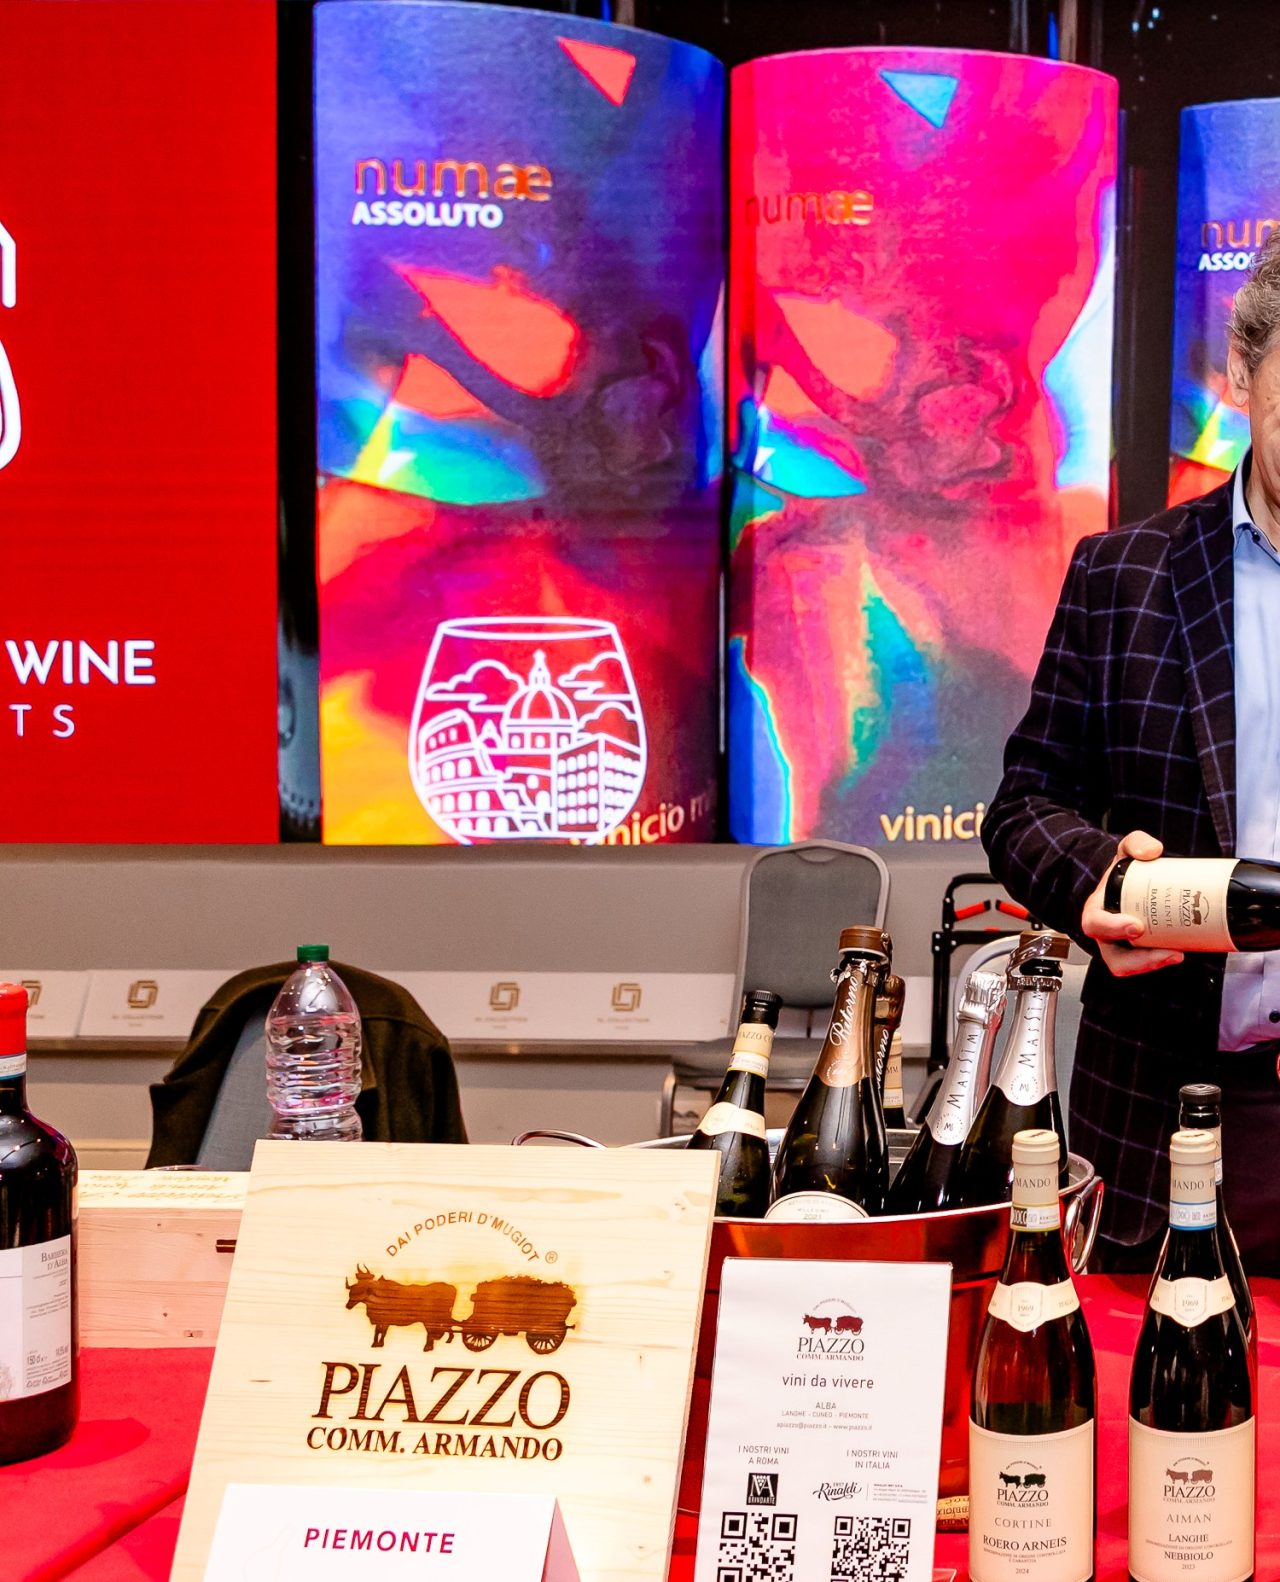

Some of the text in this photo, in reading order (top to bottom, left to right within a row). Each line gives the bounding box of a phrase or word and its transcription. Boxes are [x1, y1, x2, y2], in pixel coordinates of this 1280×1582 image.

[352, 201, 503, 228] ASSOLUTO
[1199, 251, 1254, 271] ASSO
[5, 639, 157, 685] WINE
[879, 803, 986, 842] vinici
[1150, 888, 1159, 926] BAROLO
[1182, 889, 1192, 927] PIAZZO
[386, 1231, 411, 1257] DAI
[414, 1211, 473, 1236] PODERI
[797, 1337, 865, 1355] PIAZZO
[782, 1373, 875, 1390] vini da vivere
[312, 1361, 571, 1431] PIAZZO
[815, 1402, 837, 1410] ALBA
[306, 1426, 564, 1462] COMM. ARMANDO
[743, 1445, 772, 1455] NOSTRI
[773, 1446, 790, 1456] VINI
[748, 1457, 779, 1466] A ROMA
[851, 1449, 881, 1459] NOSTRI
[882, 1450, 899, 1459] VINI
[855, 1461, 891, 1470] IN ITALIA
[812, 1481, 863, 1502] Rinaldi
[997, 1488, 1049, 1503] PIAZZO
[1164, 1485, 1216, 1498] PIAZZO
[994, 1517, 1052, 1529] CORTINE
[1166, 1513, 1212, 1524] AIMAN
[303, 1527, 456, 1555] PIEMONTE
[983, 1534, 1067, 1551] ROERO ARNEIS
[1168, 1533, 1209, 1543] LANGHE
[1164, 1551, 1214, 1561] NEBBIOLO
